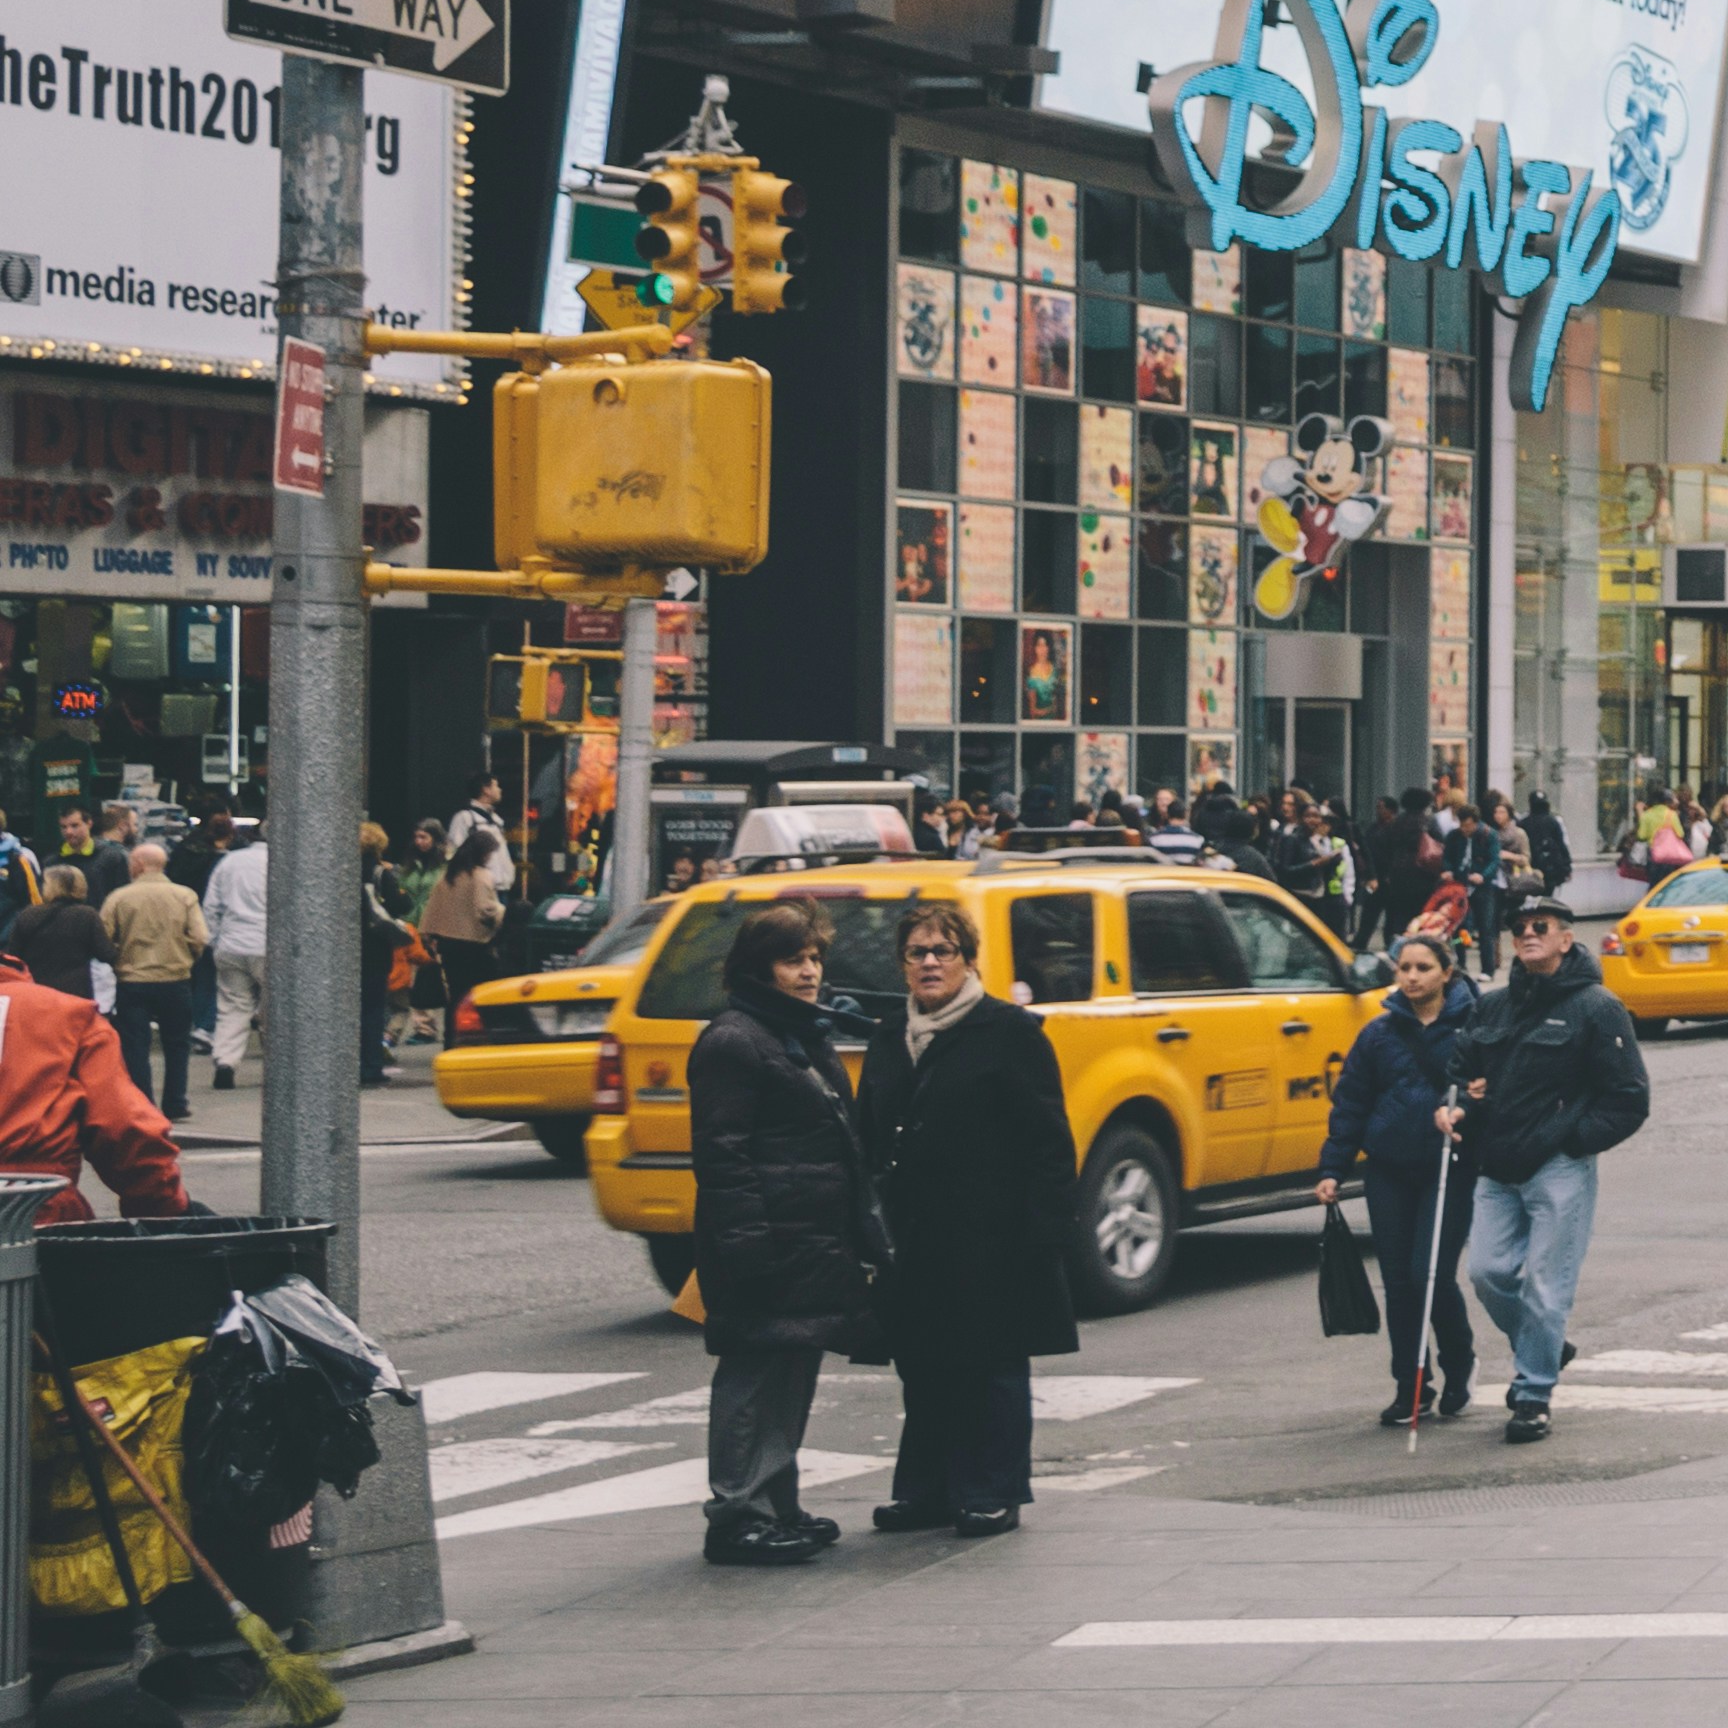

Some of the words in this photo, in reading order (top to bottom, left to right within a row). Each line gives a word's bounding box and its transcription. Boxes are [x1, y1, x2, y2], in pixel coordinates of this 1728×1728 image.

[46, 265, 156, 306] media
[167, 280, 279, 320] resear
[15, 392, 275, 480] DIGITA
[126, 484, 165, 531] &
[9, 543, 69, 571] PHOTO
[93, 548, 174, 574] LUGGAGE
[61, 691, 96, 710] ATM
